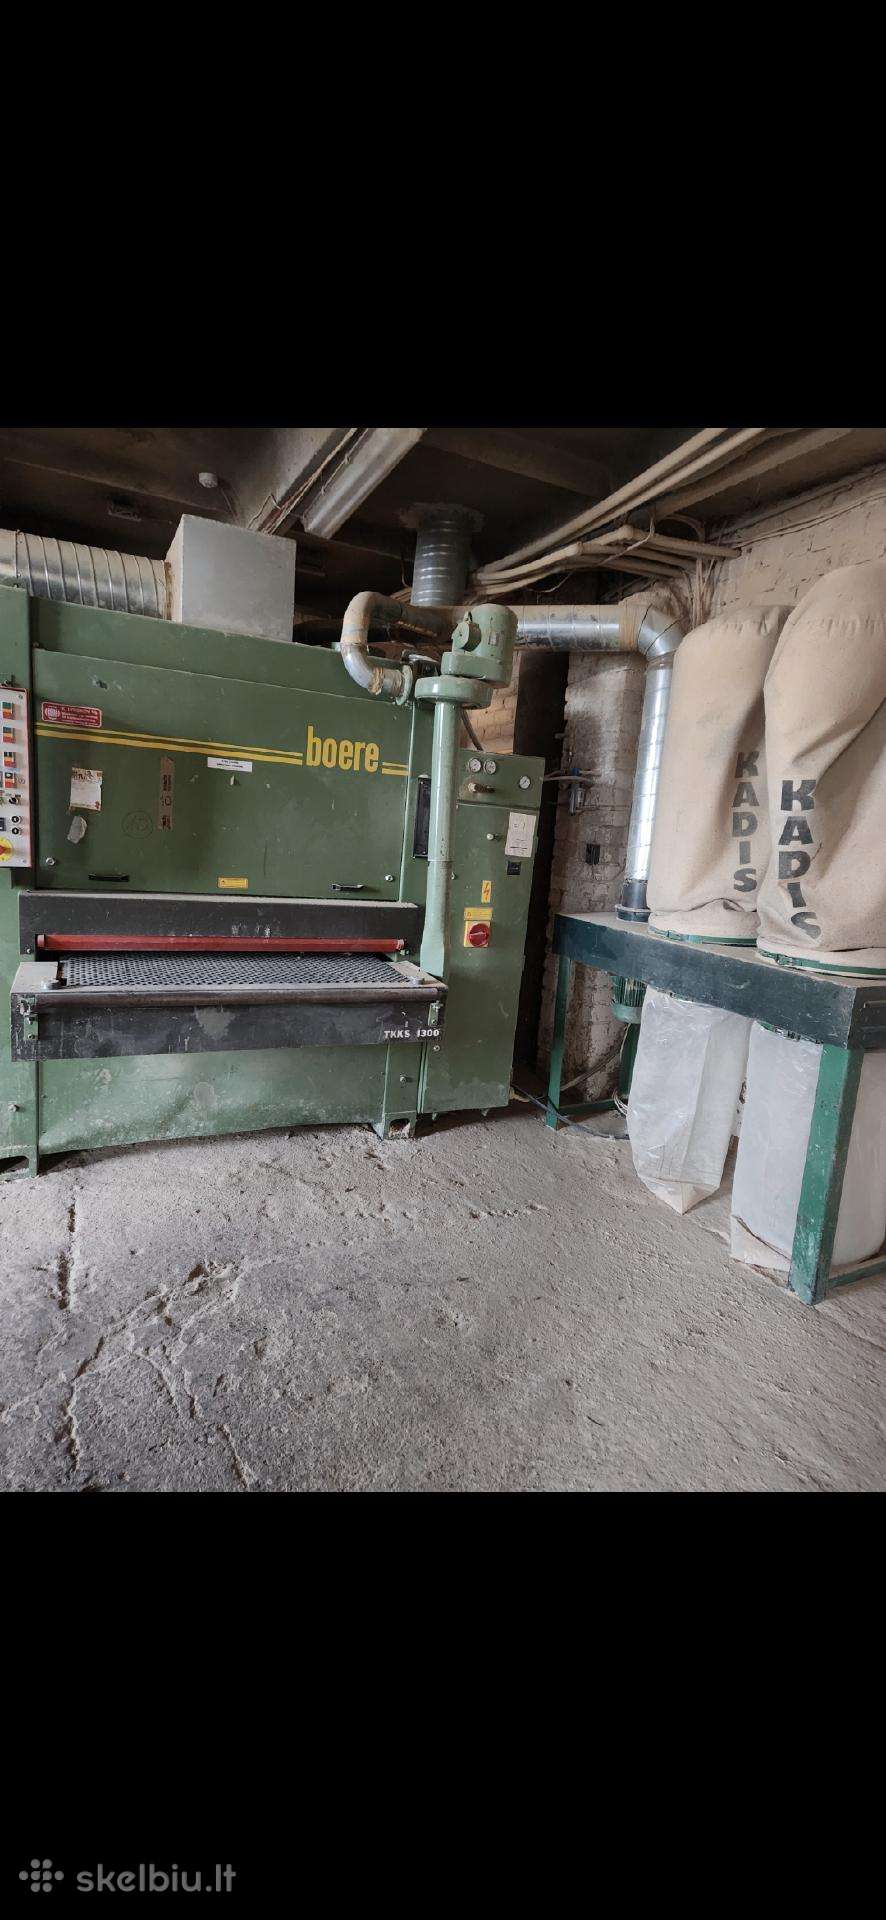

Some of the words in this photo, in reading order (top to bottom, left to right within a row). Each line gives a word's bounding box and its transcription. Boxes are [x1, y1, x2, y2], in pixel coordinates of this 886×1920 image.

[306, 725, 379, 773] boere
[732, 751, 760, 892] KADIS
[778, 779, 821, 939] KADIS
[384, 1030, 410, 1039] TKKS
[417, 1029, 439, 1038] 1300
